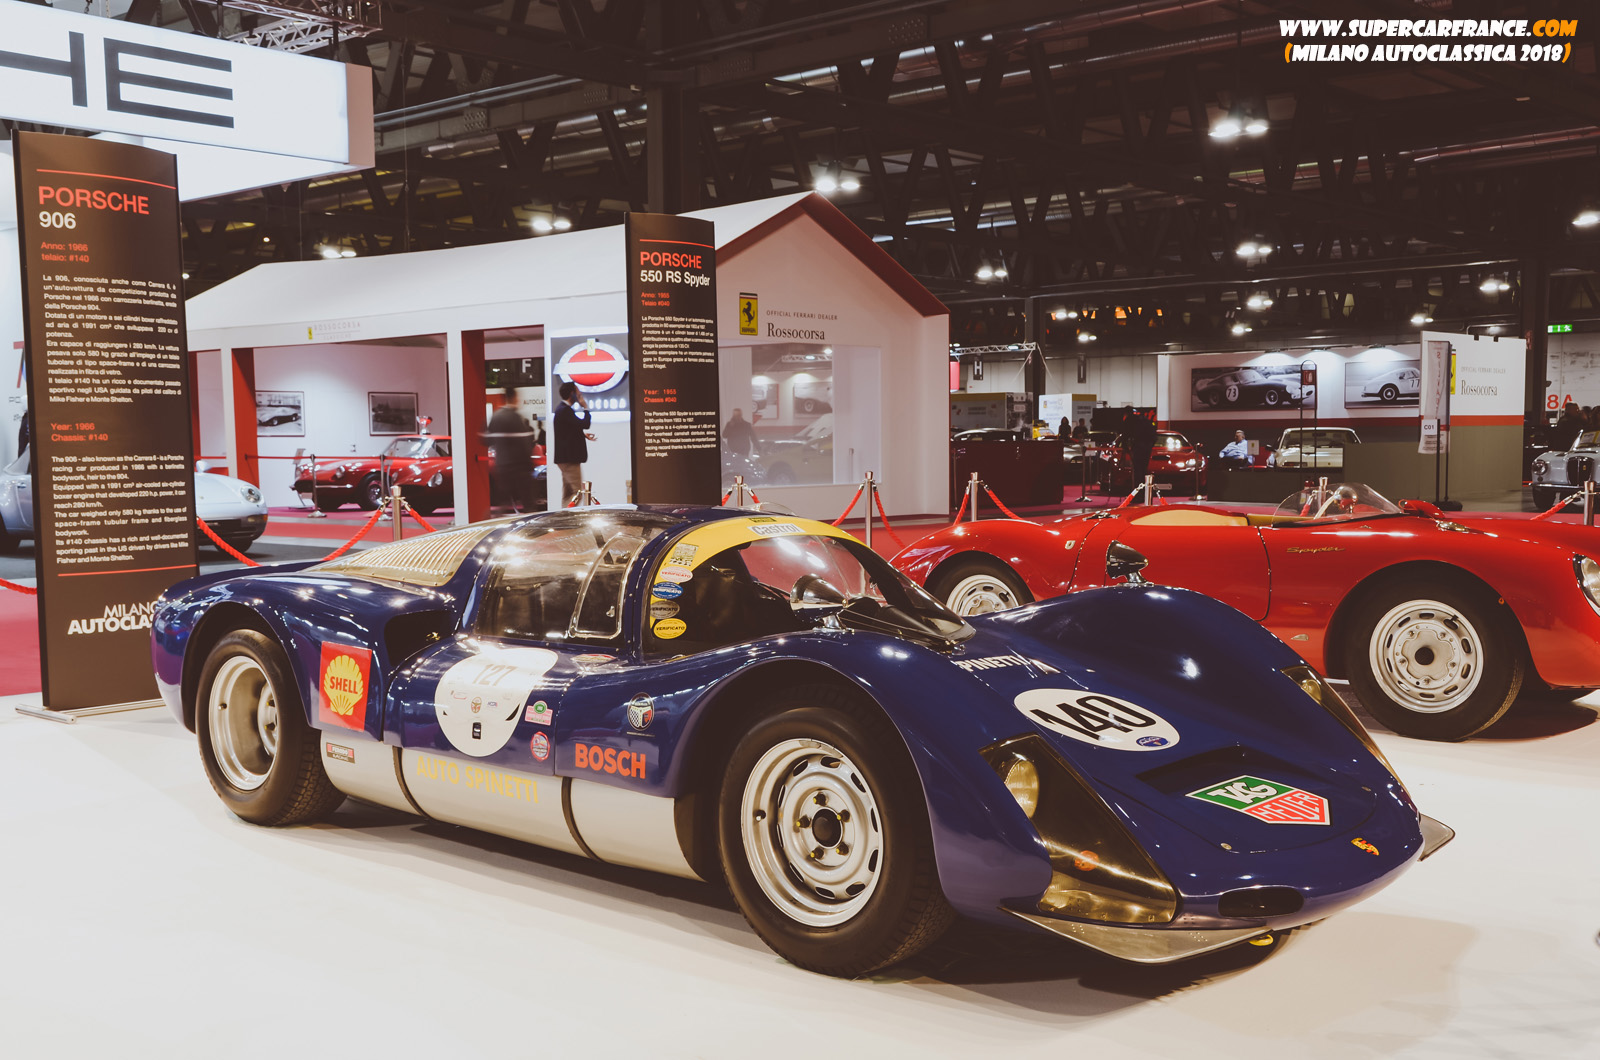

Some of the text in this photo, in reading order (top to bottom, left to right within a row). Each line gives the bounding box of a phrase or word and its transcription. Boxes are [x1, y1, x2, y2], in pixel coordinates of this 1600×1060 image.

[39, 186, 149, 215] PORSCHE
[39, 211, 76, 229] 906
[41, 242, 88, 251] Anno: 1966
[41, 253, 89, 262] telaio: #140
[640, 251, 702, 269] PORSCHE
[640, 270, 710, 287] 550 RS Spyder
[793, 311, 816, 319] FERRARI
[767, 322, 825, 340] Rossocorsa
[522, 359, 532, 373] F
[975, 361, 982, 375] H
[1227, 387, 1237, 398] 73
[1461, 379, 1497, 396] Rossocorsa
[88, 433, 108, 441] #140
[52, 465, 72, 473] racing
[53, 483, 84, 491] Equipped
[752, 524, 800, 535] Castrol
[56, 547, 82, 555] sporting
[472, 664, 518, 686] 127
[330, 676, 358, 694] SHELL
[1030, 696, 1156, 740] 140
[575, 743, 646, 779] BOSCH
[417, 755, 538, 803] AUTO SPINETTI
[1207, 782, 1278, 804] TAG
[1252, 792, 1320, 821] HEUER
